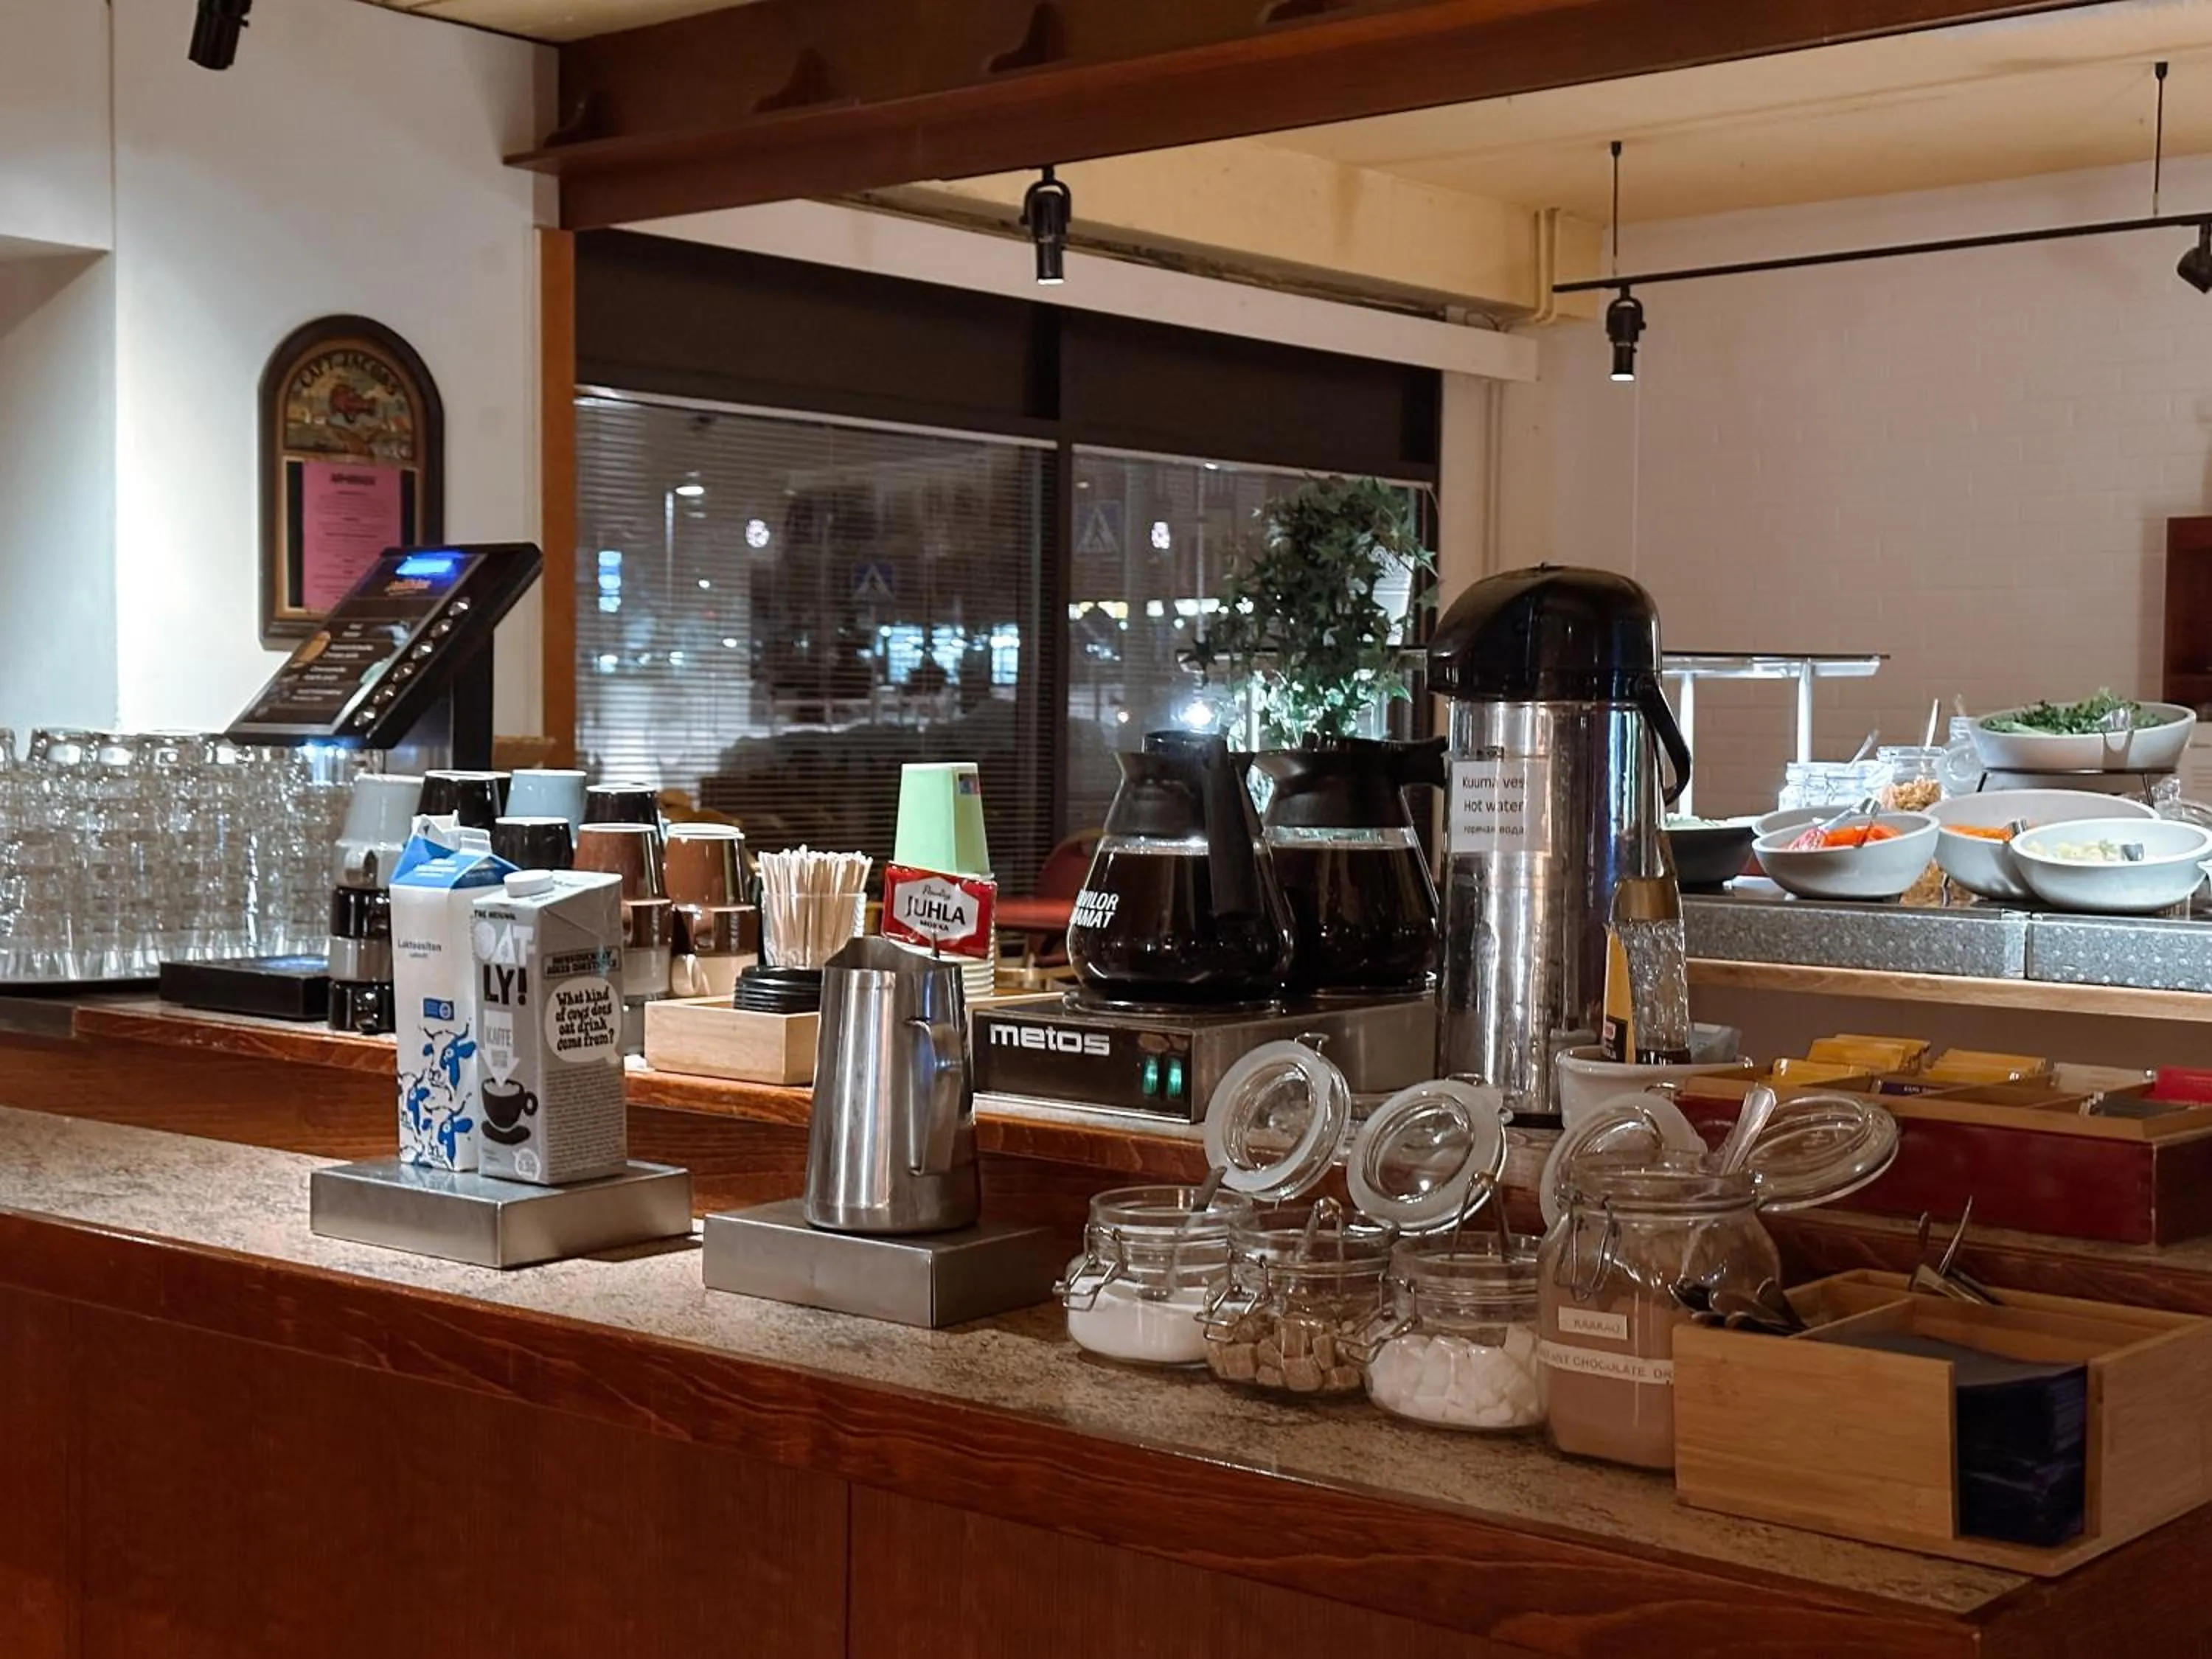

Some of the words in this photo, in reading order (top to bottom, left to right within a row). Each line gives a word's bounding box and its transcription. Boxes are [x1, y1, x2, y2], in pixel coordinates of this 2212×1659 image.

[1502, 777, 1525, 789] ves
[1464, 800, 1482, 812] Hot
[905, 895, 965, 925] JUHLA
[483, 964, 527, 1006] LY!
[555, 990, 584, 1006] What
[585, 985, 610, 1003] kind
[555, 1007, 566, 1022] of
[577, 1017, 607, 1033] drink
[990, 1023, 1110, 1056] metos
